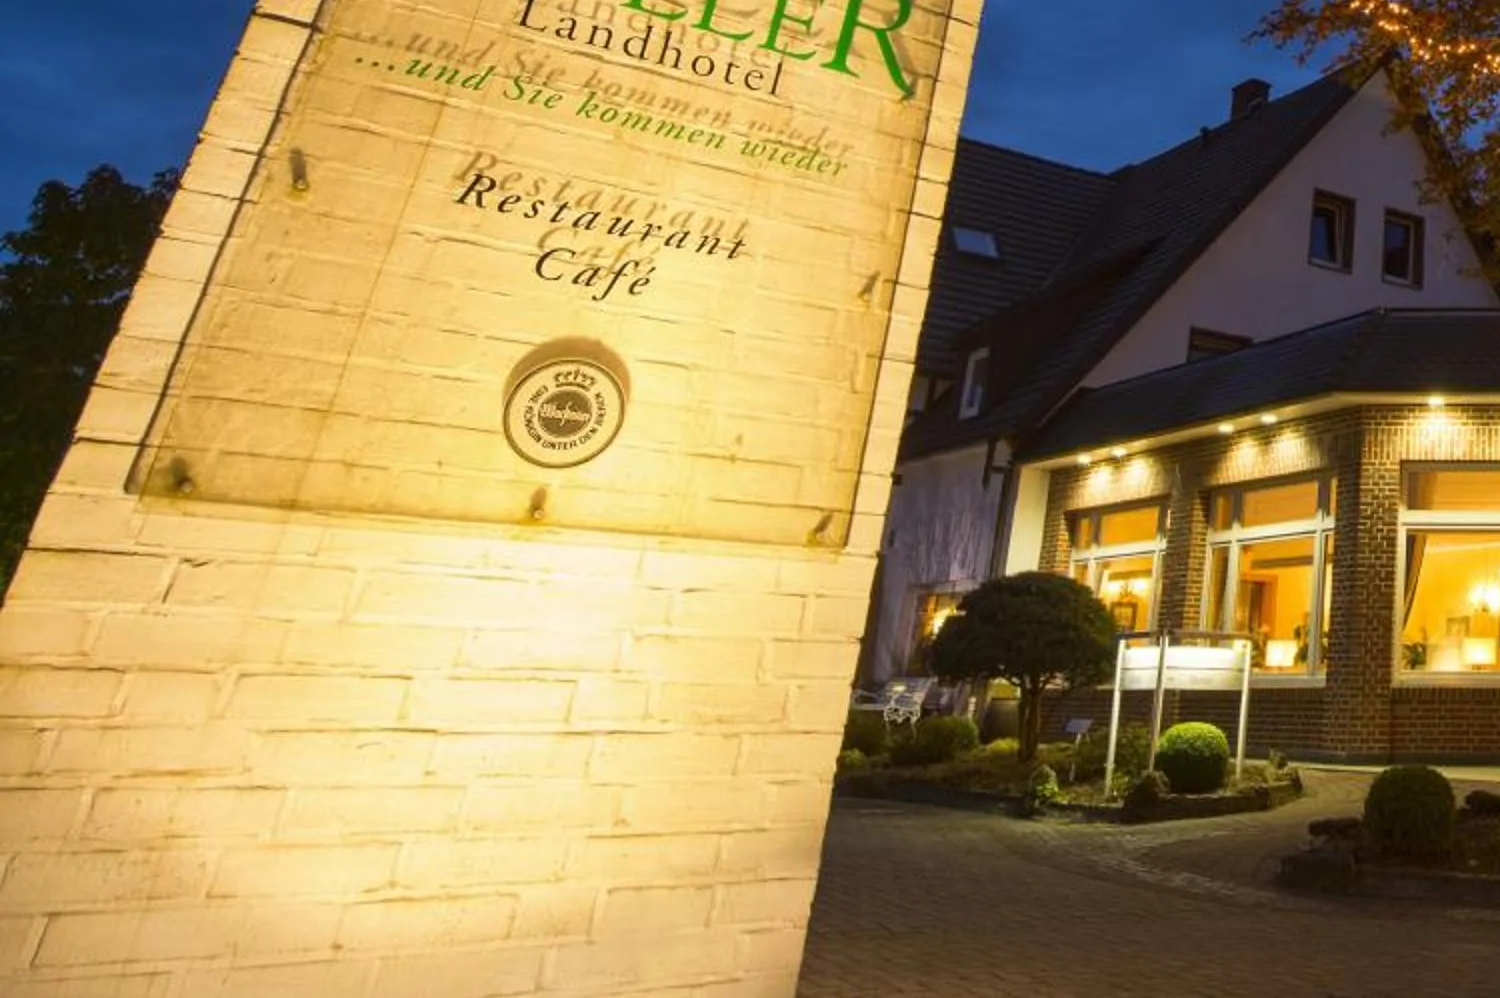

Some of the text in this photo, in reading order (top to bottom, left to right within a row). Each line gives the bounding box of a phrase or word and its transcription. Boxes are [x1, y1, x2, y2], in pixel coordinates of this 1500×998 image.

[504, 69, 561, 111] Sie
[575, 87, 726, 151] kommen
[740, 138, 848, 179] wieder
[454, 172, 748, 261] Restaurant
[534, 247, 656, 301] Café
